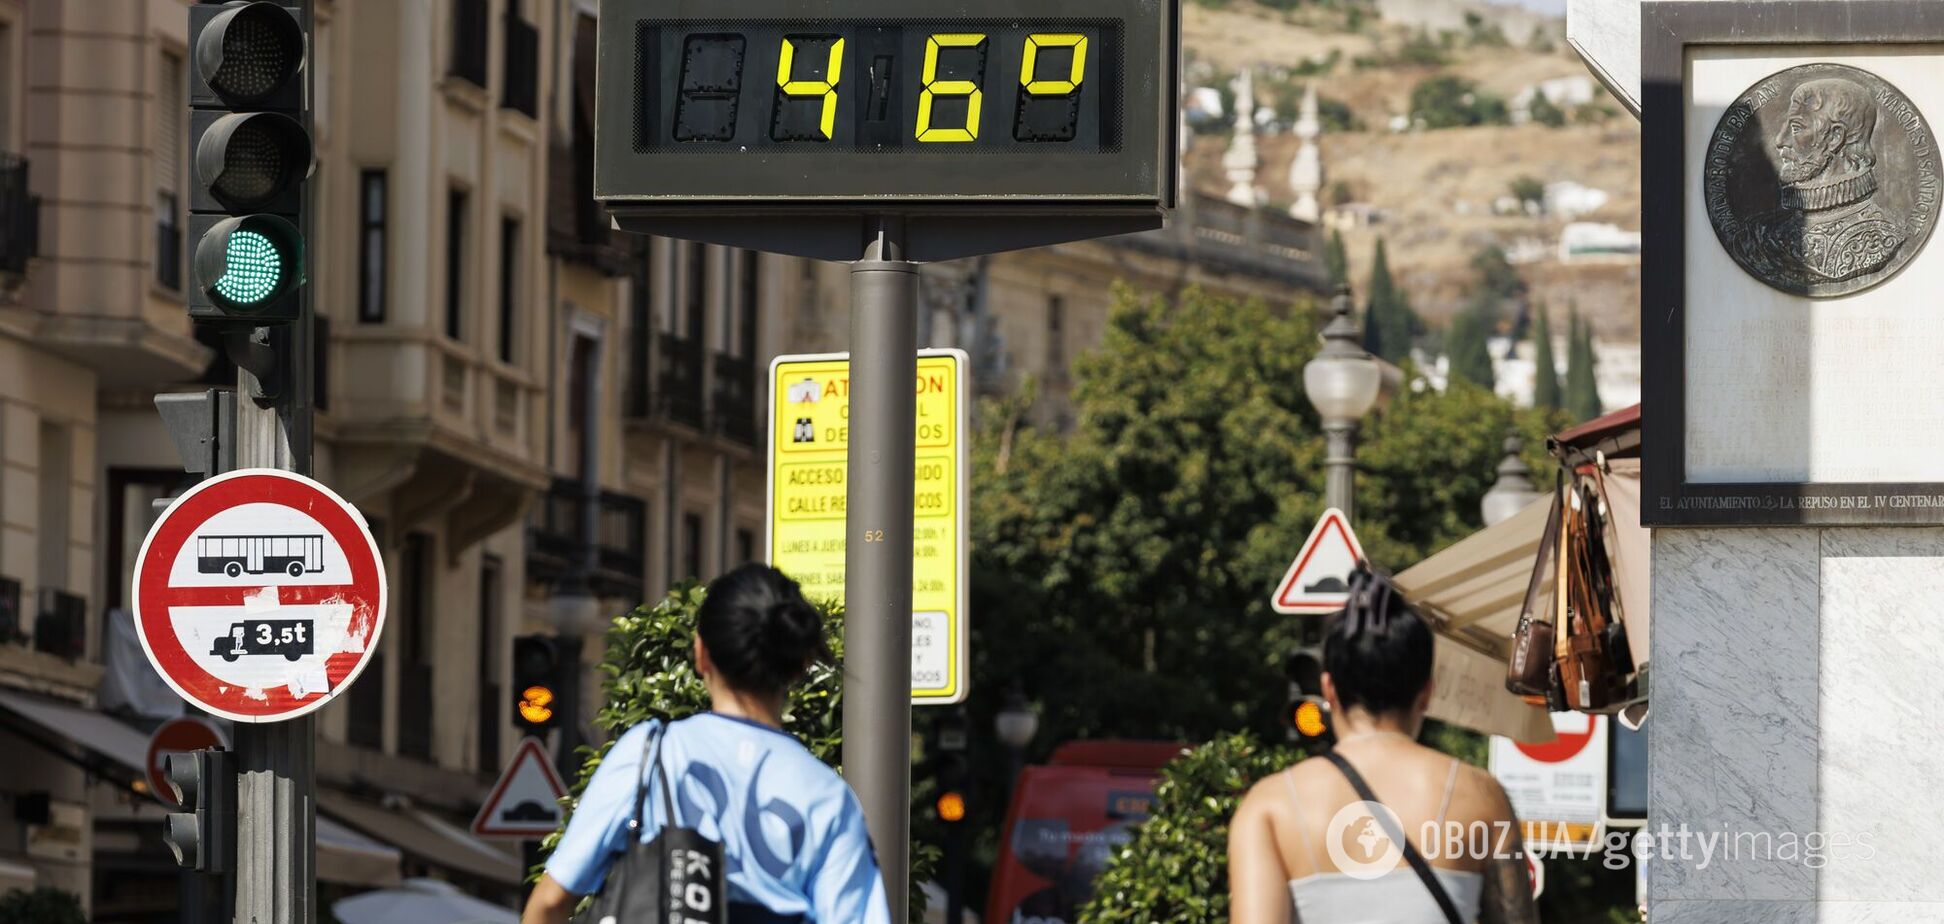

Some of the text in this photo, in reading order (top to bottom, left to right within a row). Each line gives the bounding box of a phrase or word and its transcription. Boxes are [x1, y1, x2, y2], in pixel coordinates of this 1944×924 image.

[788, 467, 844, 486] ACCESO
[788, 496, 827, 514] CALLE
[1659, 496, 1673, 510] EL
[1677, 496, 1760, 510] AYUNTAMIENTO
[1780, 496, 1795, 509] LA
[1799, 496, 1838, 509] REPUSO
[1840, 496, 1856, 509] EN
[1857, 496, 1872, 509] EL
[1874, 495, 1888, 508] IV
[864, 529, 885, 543] 52
[256, 622, 307, 646] 3,5t
